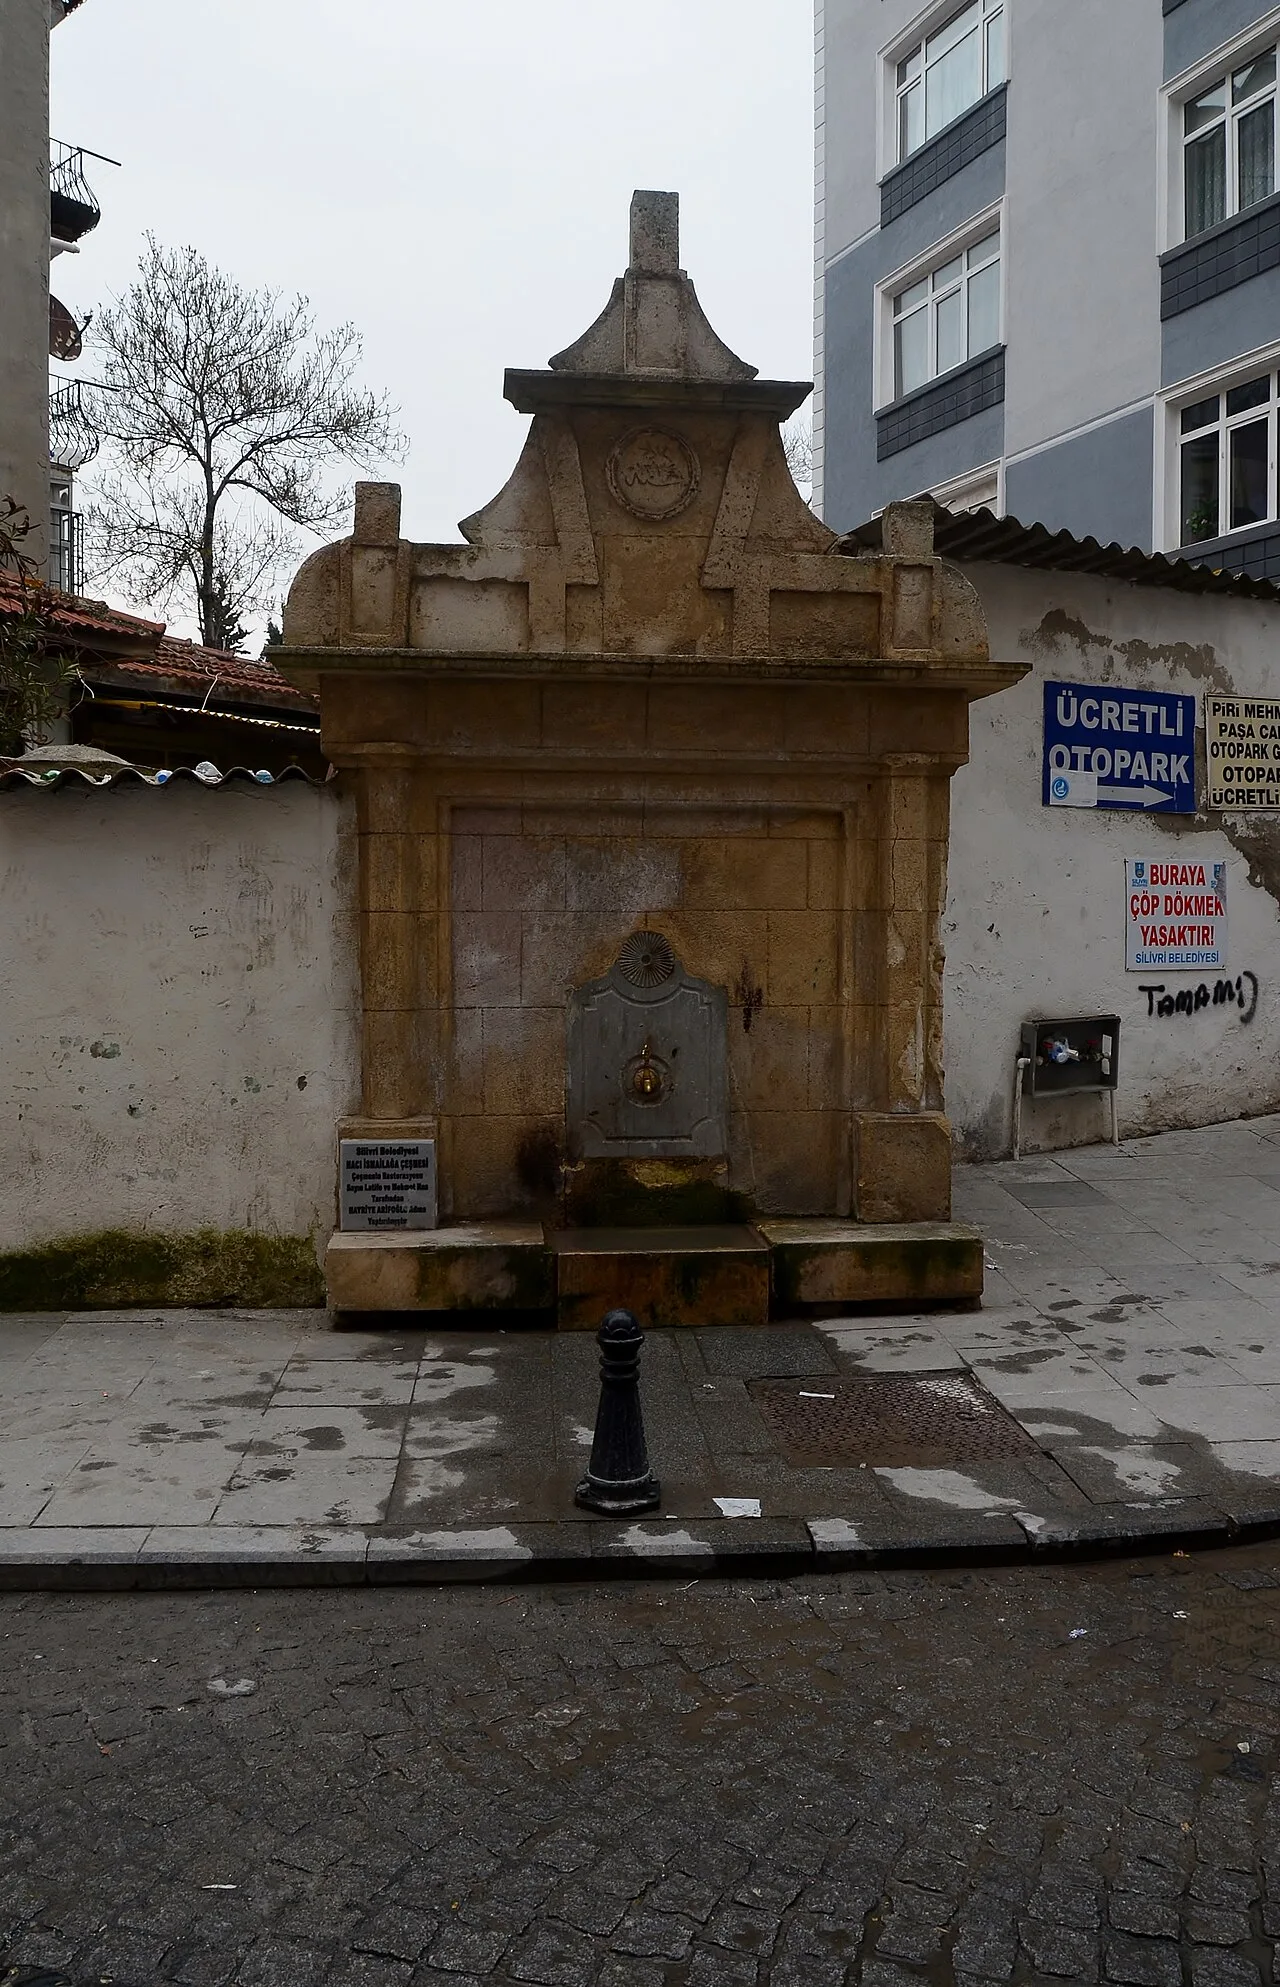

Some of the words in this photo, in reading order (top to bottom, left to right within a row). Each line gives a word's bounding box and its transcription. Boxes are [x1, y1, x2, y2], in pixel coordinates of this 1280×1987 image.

[1056, 689, 1184, 737] ÜCRETLİ
[1219, 722, 1256, 741] PAŞA
[1210, 741, 1270, 760] OTOPARK
[1049, 743, 1191, 784] OTOPARK
[1150, 864, 1206, 886] BURAYA
[1130, 890, 1160, 921] ÇÖP
[1164, 890, 1224, 917] DÖKMEK
[1140, 925, 1215, 946] YASAKTIR!
[1135, 951, 1167, 964] SİLİVRİ
[1168, 950, 1219, 963] BELEDİYESİ
